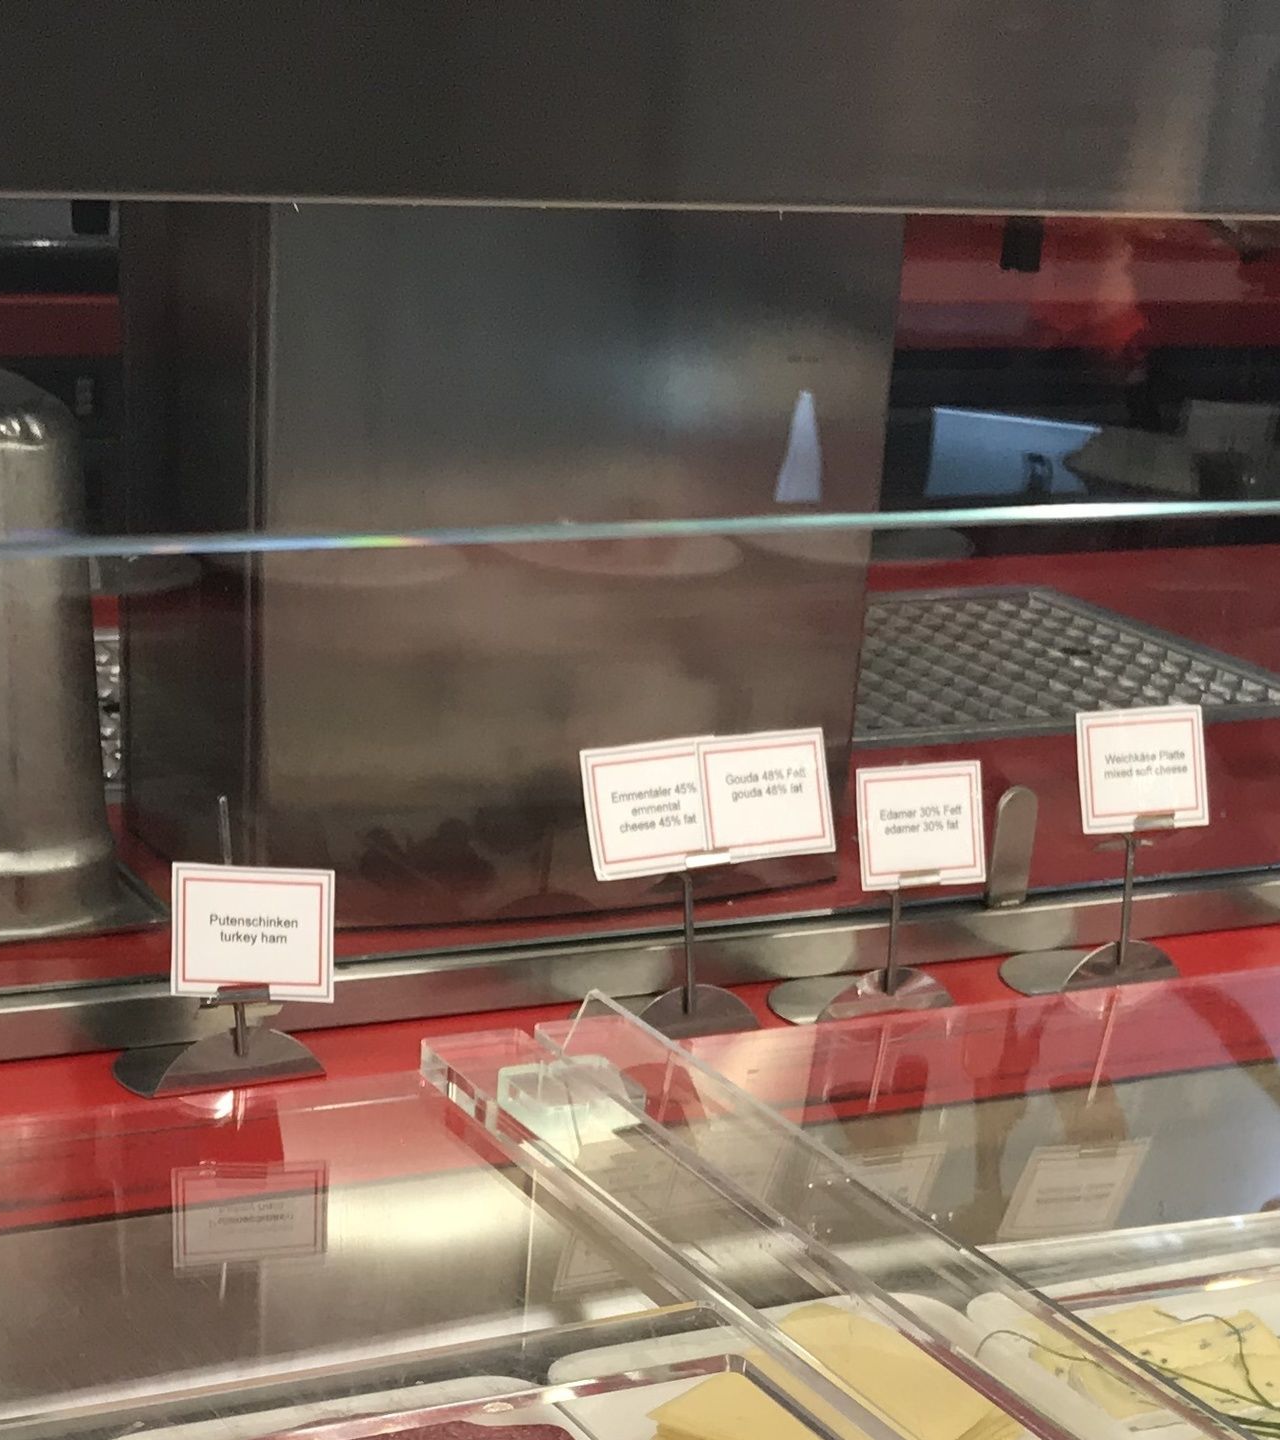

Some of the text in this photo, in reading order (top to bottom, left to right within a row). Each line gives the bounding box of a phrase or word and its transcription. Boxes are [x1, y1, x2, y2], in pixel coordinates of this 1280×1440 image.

[1105, 750, 1185, 764] Weichkäse Platte
[725, 772, 759, 786] Gouda
[762, 770, 784, 781] 48%
[1105, 764, 1188, 778] mixed soft cheese
[611, 782, 697, 803] Emmentaler 45%
[731, 788, 762, 802] gouda
[790, 783, 803, 793] fat
[631, 801, 680, 817] emmental
[880, 805, 961, 821] Edamer 30% Fett
[620, 814, 697, 833] cheese 45% fat
[885, 820, 958, 835] edamer 30% fat
[209, 914, 298, 928] Putenschinken
[220, 932, 287, 945] turkey ham
